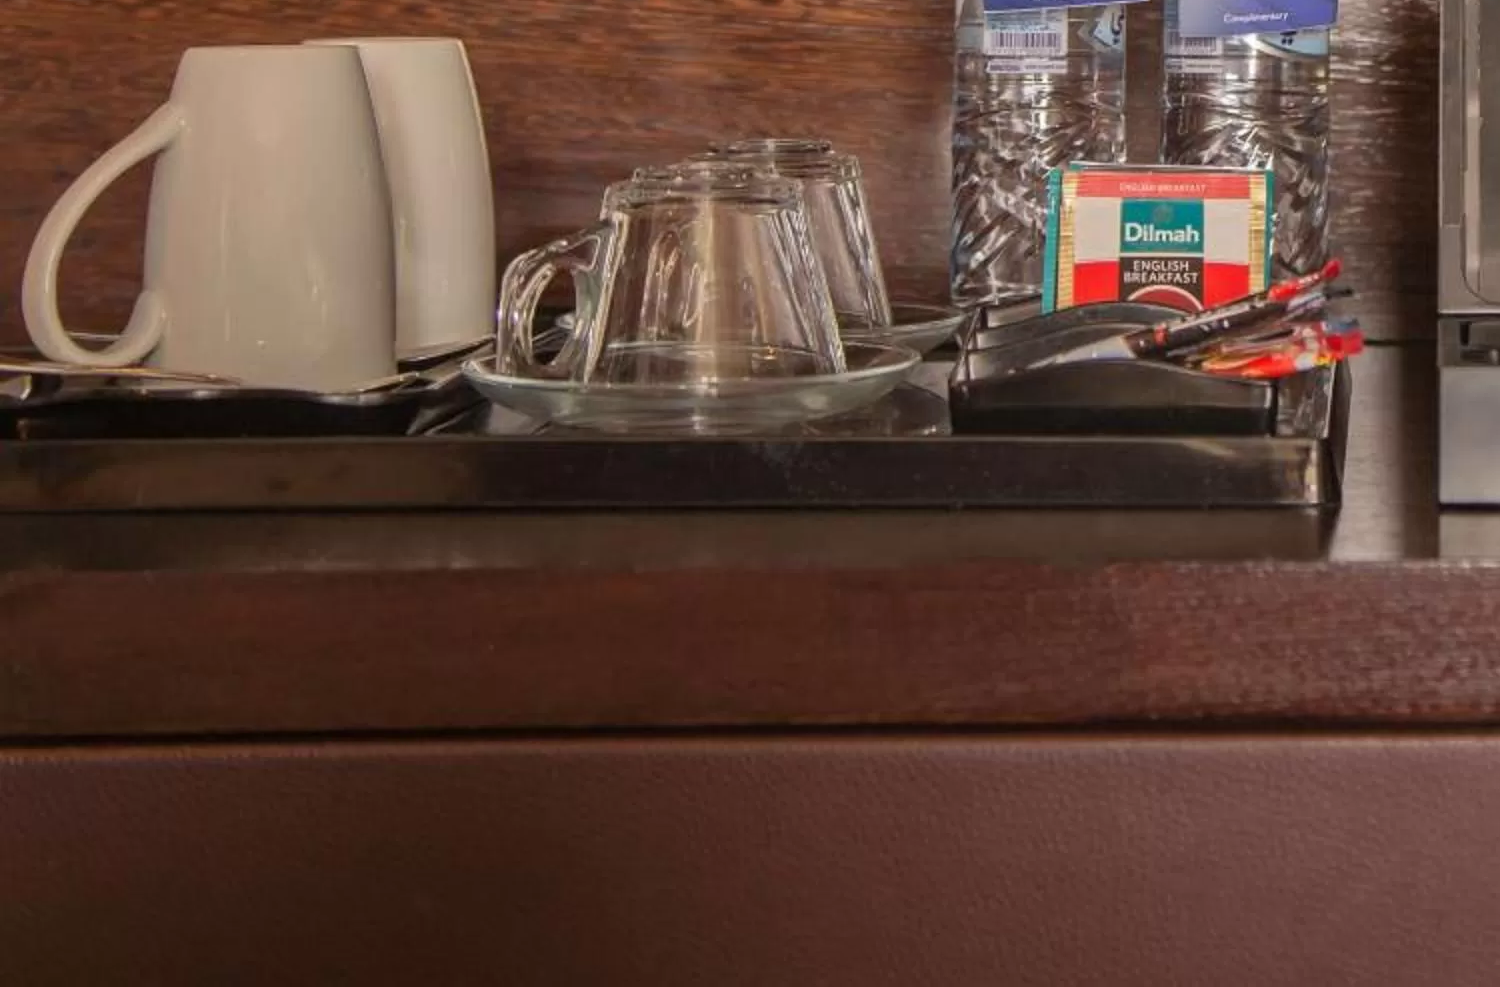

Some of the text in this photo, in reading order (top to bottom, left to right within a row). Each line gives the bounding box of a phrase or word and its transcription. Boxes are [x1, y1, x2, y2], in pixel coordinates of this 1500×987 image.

[1123, 222, 1200, 243] Dilmah
[1132, 260, 1189, 272] ENGLISH
[1123, 272, 1198, 284] BREAKFAST
